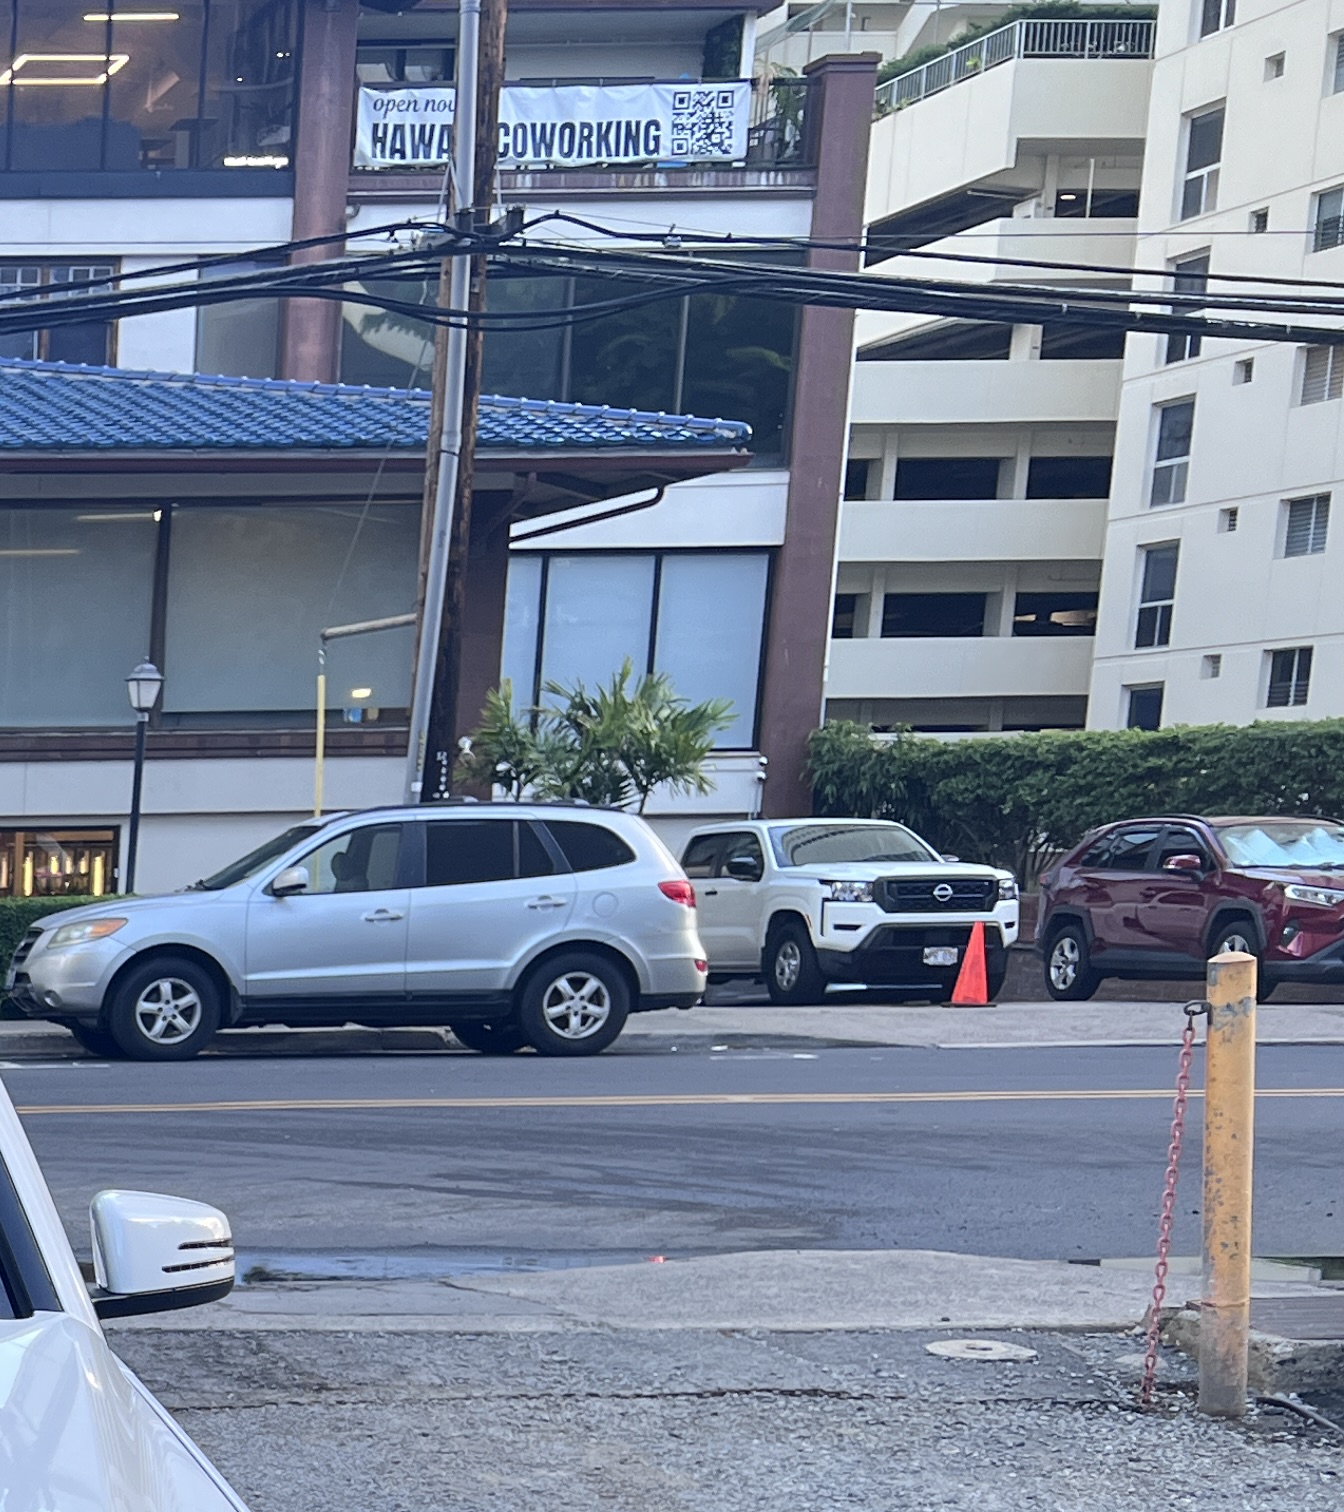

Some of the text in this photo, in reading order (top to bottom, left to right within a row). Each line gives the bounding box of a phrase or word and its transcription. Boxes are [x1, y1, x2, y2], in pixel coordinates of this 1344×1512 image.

[373, 97, 420, 119] open
[372, 119, 662, 161] HAWA COWORKING
